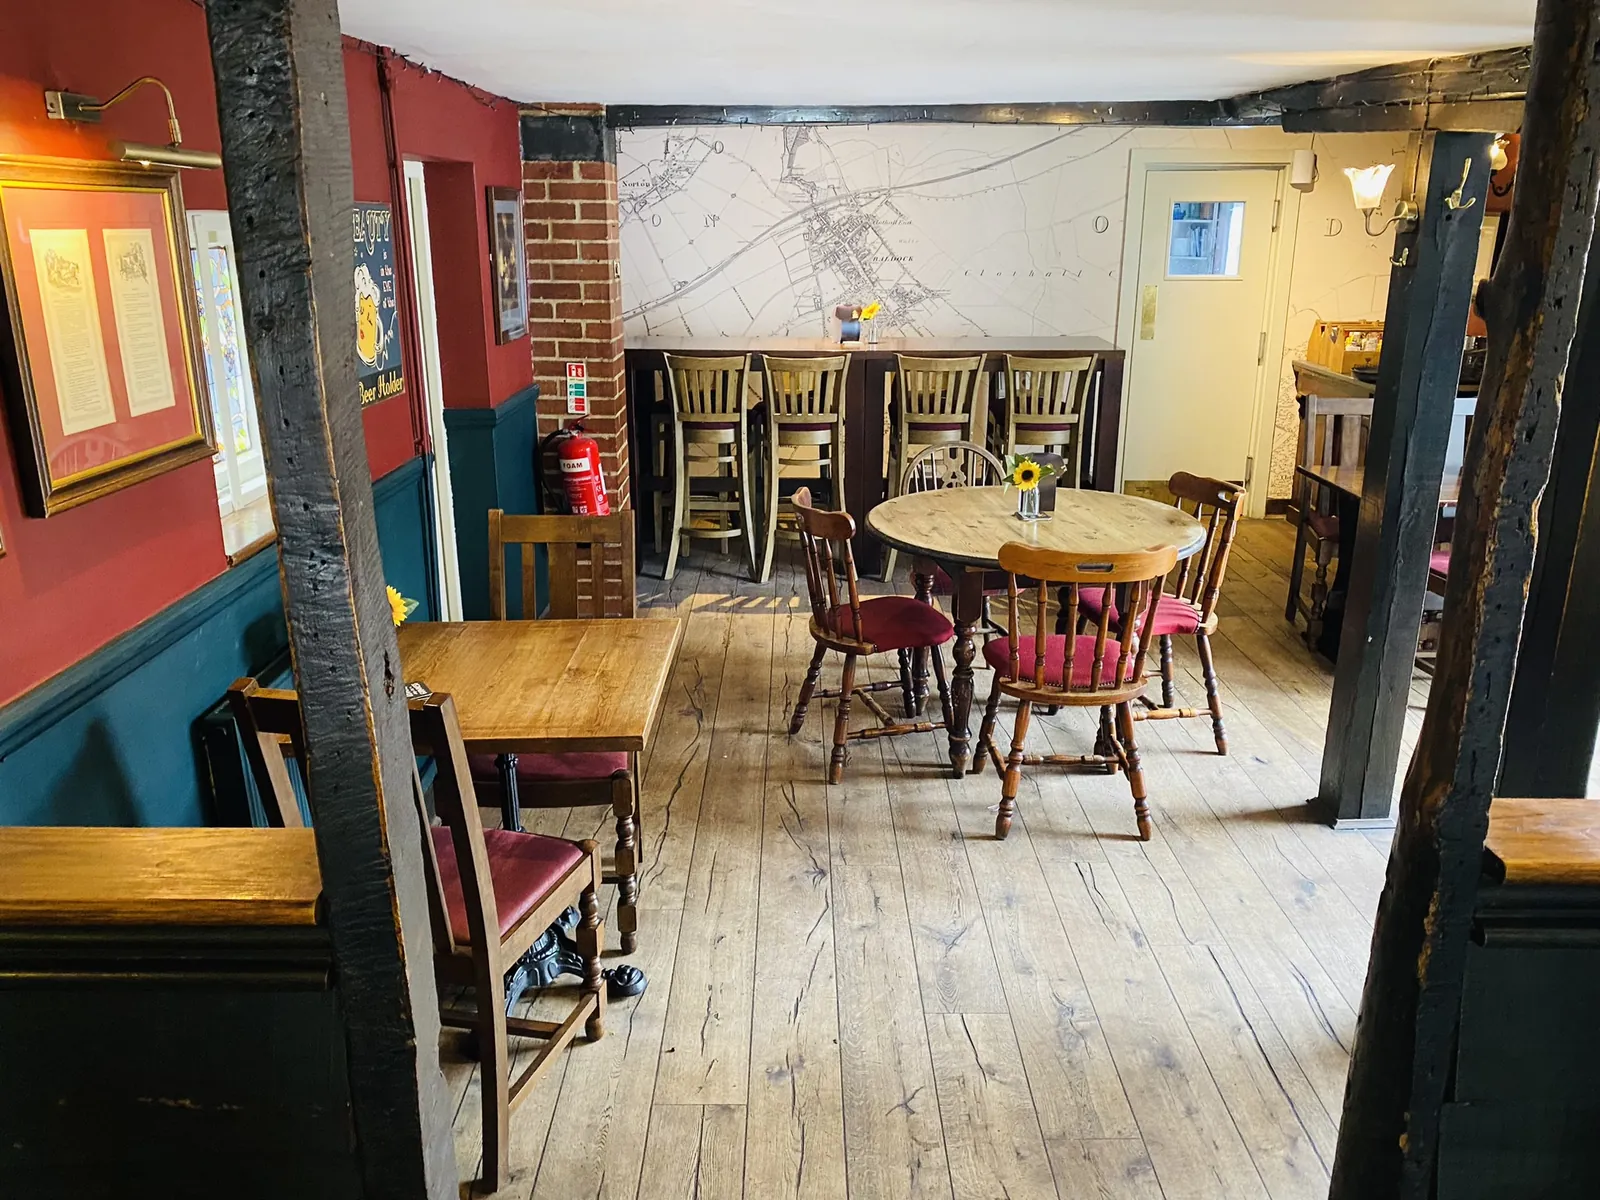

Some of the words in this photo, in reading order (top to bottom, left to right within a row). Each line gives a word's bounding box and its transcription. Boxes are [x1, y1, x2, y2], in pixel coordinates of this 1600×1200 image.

[358, 381, 377, 405] Beer
[377, 370, 404, 399] Holder
[562, 462, 584, 470] FOAM
